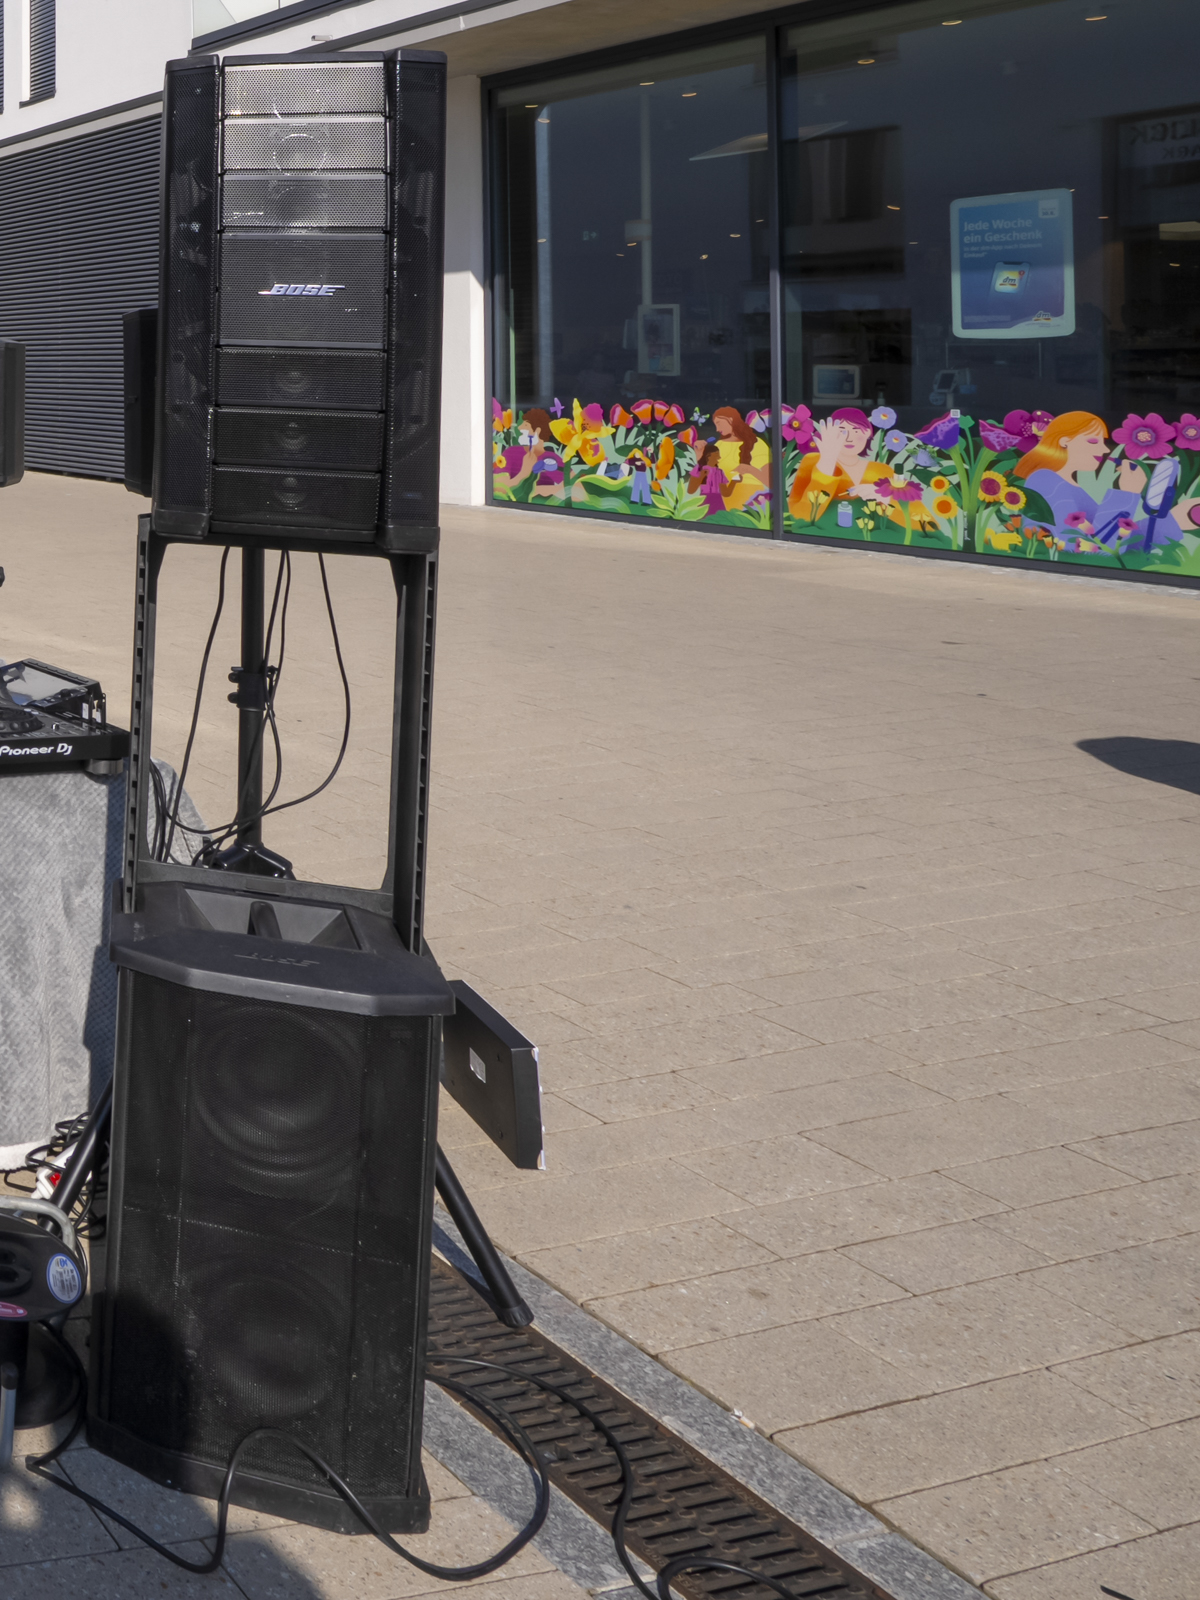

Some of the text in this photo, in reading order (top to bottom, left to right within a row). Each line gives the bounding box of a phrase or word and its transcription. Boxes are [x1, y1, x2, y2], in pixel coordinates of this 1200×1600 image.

[964, 218, 1032, 232] Jede Woche
[964, 230, 1042, 243] ein Geschenk
[258, 284, 345, 296] BOSE
